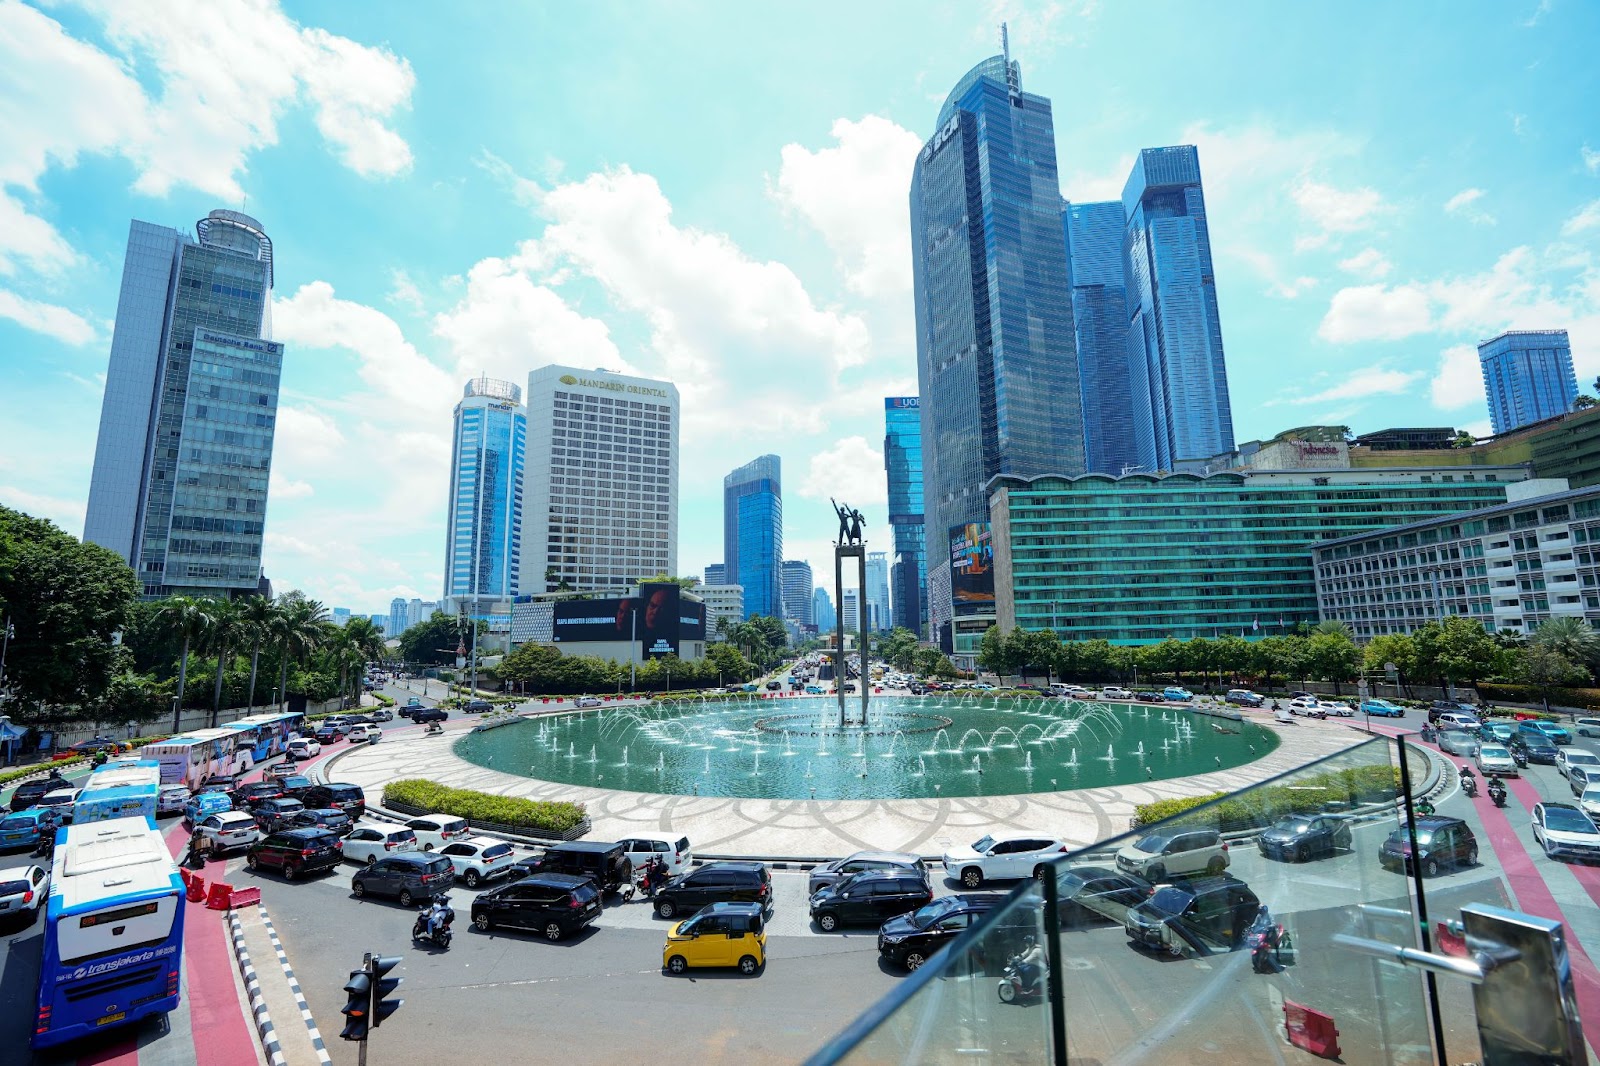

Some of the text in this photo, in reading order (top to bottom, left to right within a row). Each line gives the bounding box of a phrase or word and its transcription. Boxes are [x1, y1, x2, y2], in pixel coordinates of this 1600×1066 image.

[933, 114, 958, 152] BCA
[203, 333, 263, 351] Deutsche Bank
[579, 378, 667, 398] MANDARIN ORIENTAL
[488, 402, 513, 411] mandiri
[88, 950, 153, 975] transjakarta
